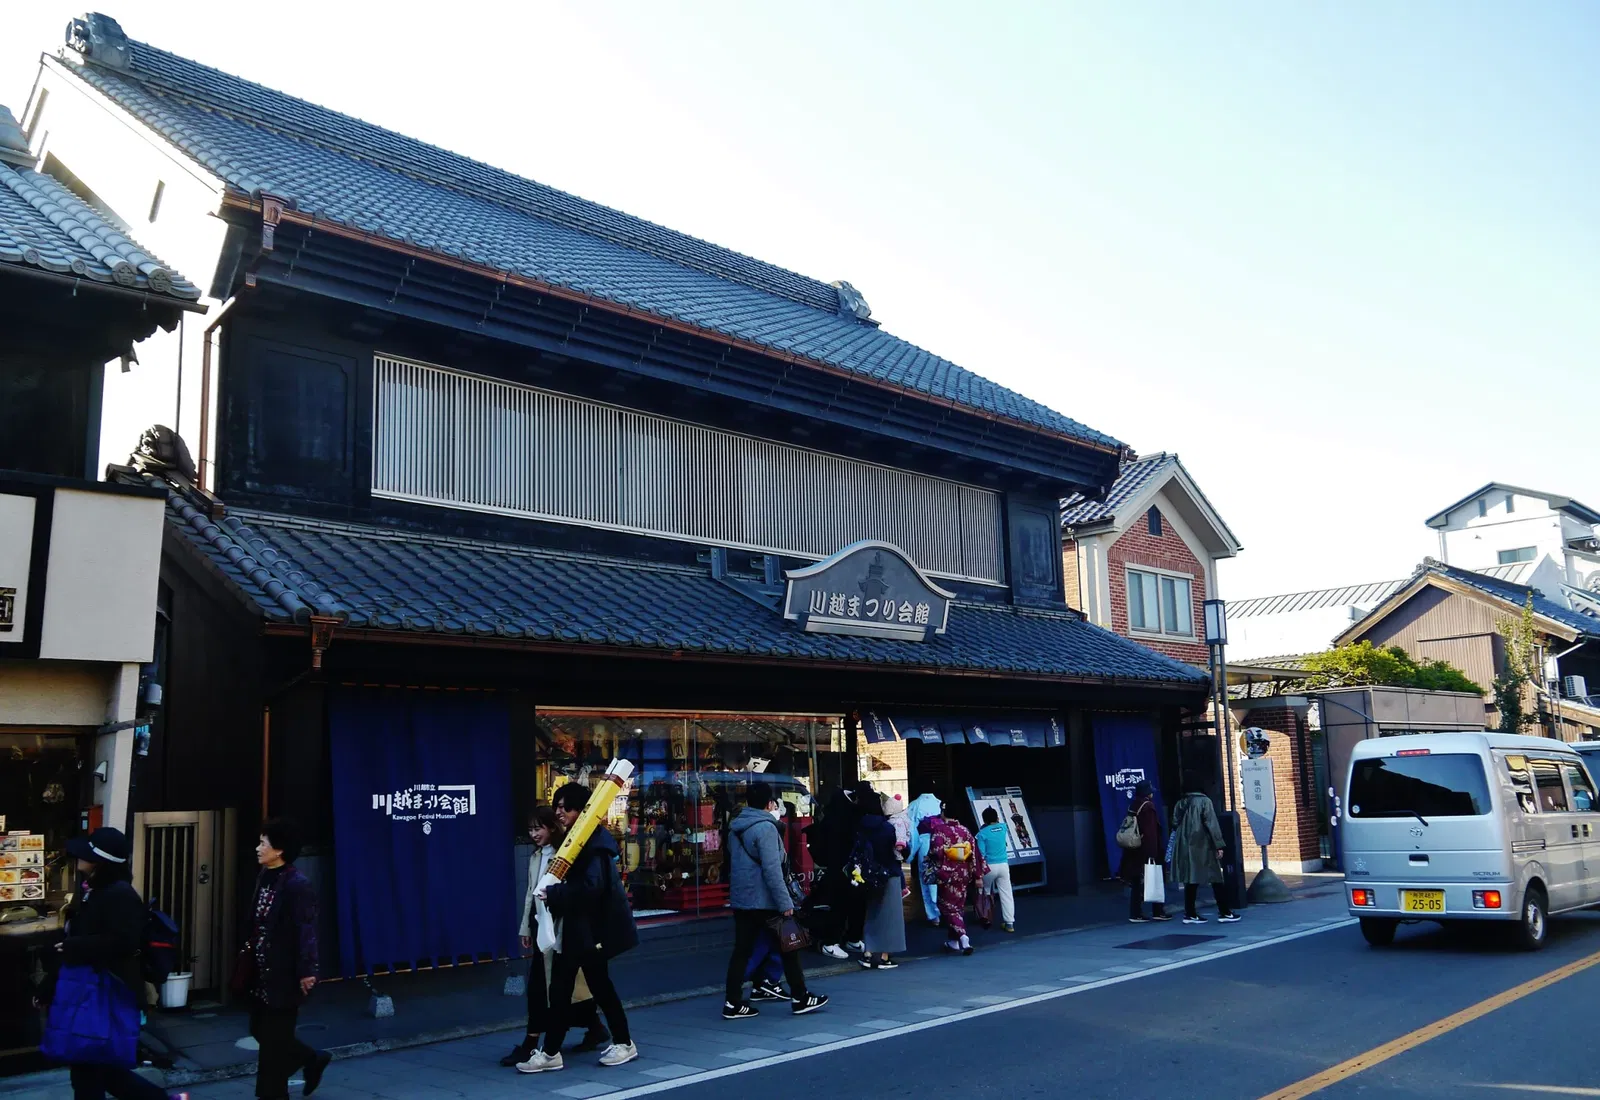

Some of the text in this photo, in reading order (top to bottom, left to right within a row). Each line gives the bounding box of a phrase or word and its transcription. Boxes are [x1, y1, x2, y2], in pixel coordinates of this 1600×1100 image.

[809, 589, 931, 625] 川越まつり会館
[372, 787, 469, 815] 川越まつり会館
[1412, 899, 1441, 910] 25-05
